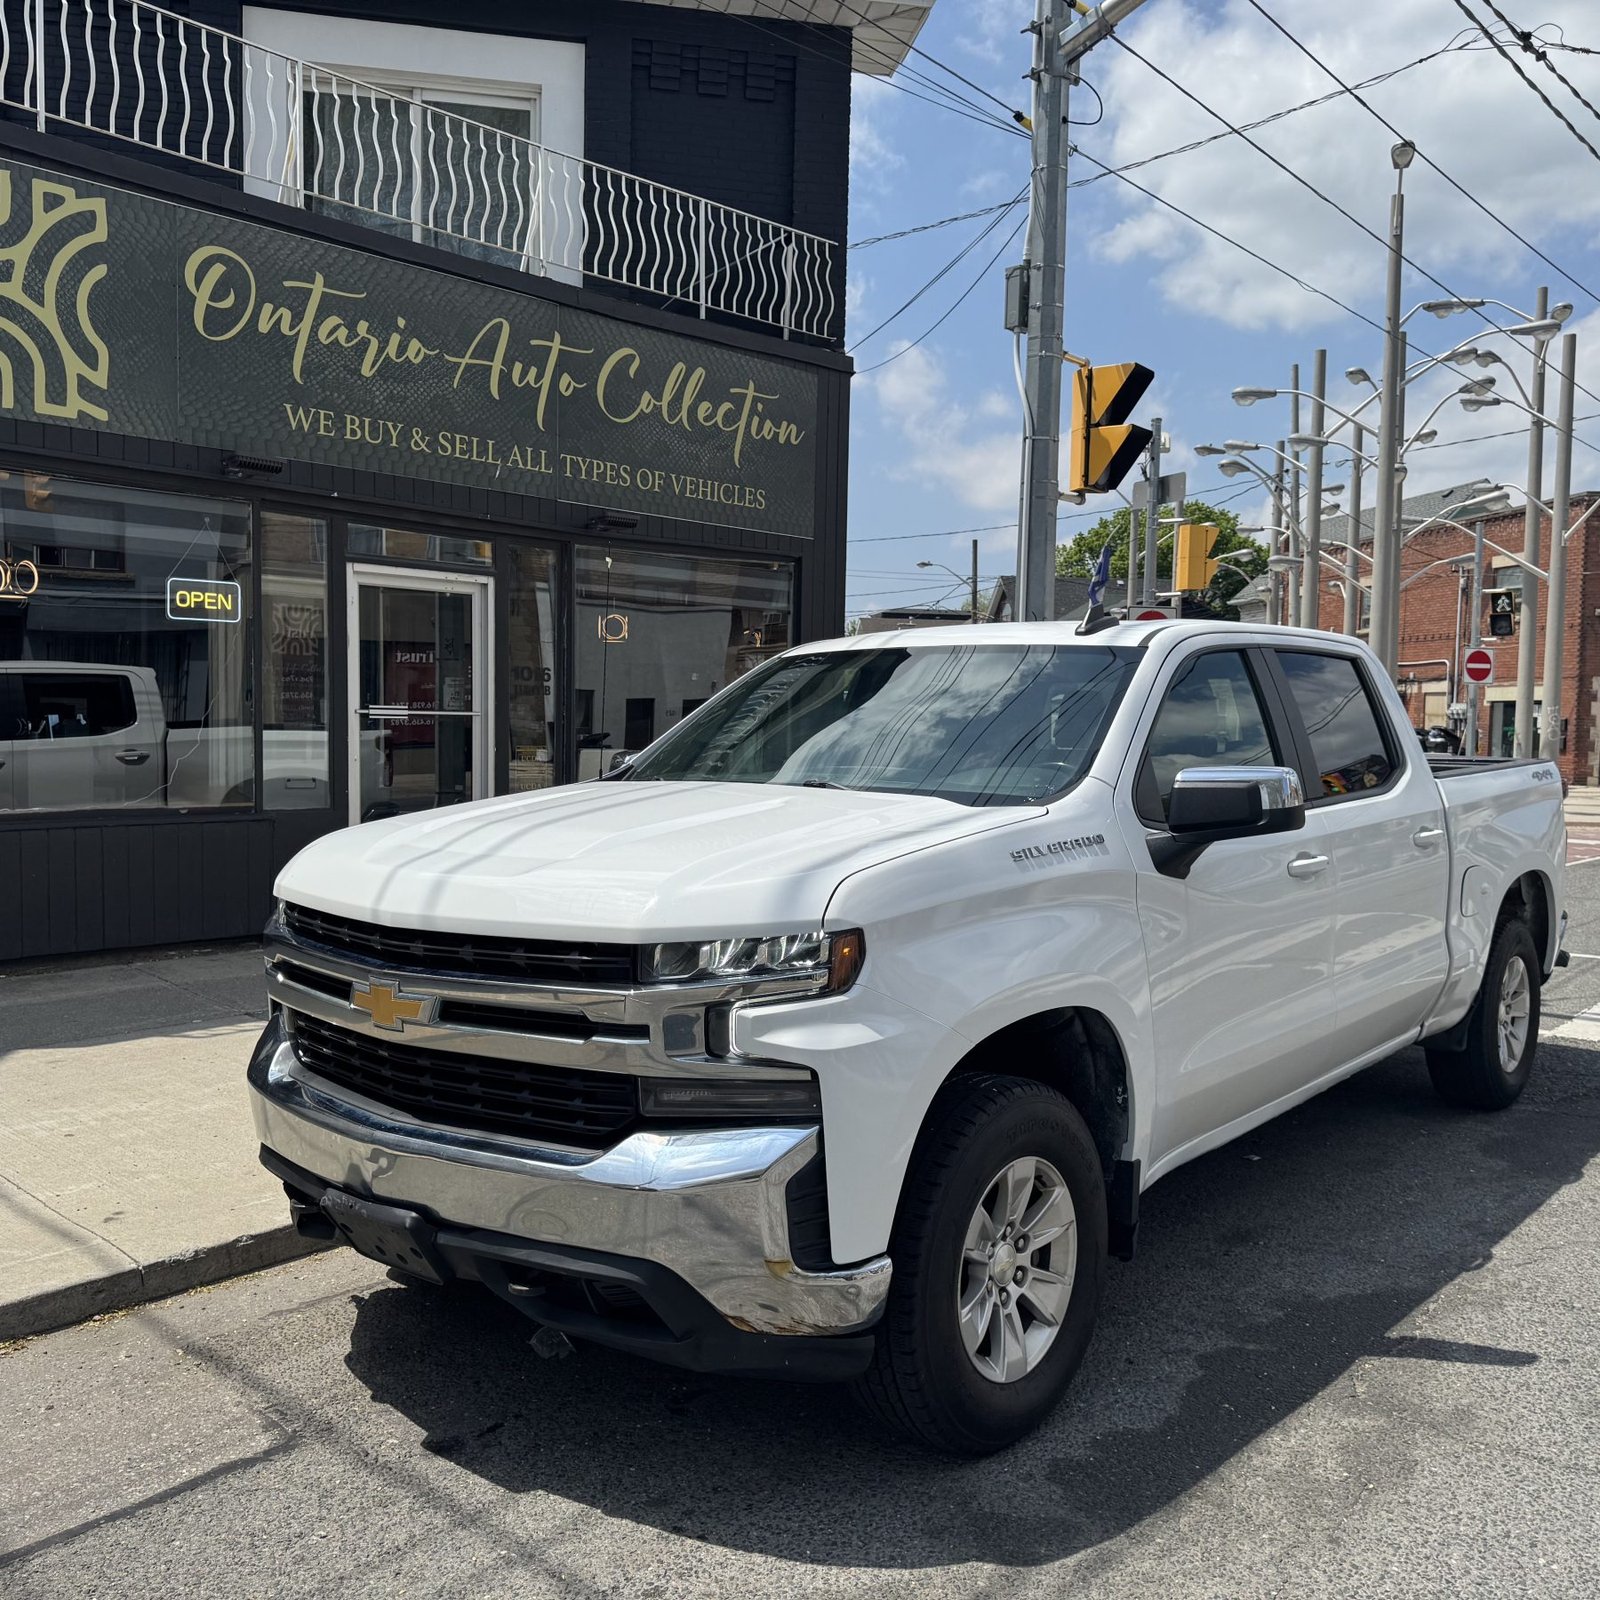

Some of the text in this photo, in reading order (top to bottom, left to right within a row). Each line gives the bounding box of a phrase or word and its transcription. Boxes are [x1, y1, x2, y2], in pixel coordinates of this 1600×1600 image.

[184, 245, 806, 468] Ontario Auto Collection
[283, 403, 767, 510] WE BUY & SELL ALL TYPES OF VEHICLES
[176, 590, 232, 610] OPEN
[1010, 833, 1105, 862] SILVERADO
